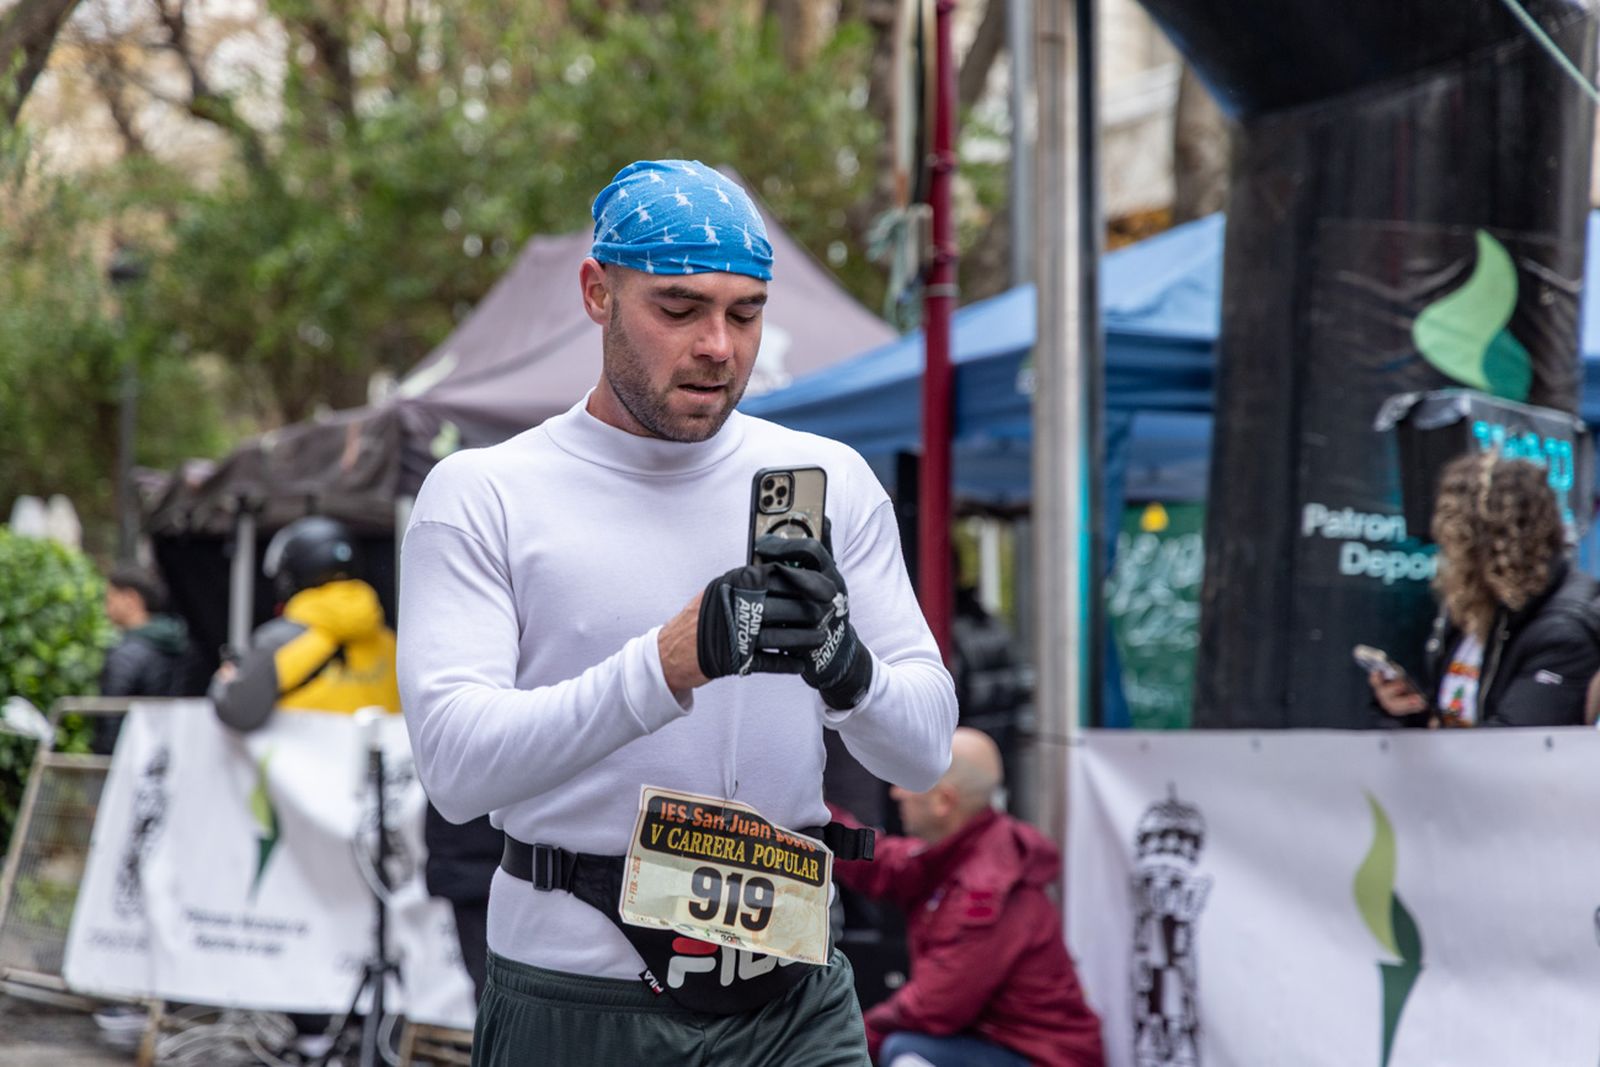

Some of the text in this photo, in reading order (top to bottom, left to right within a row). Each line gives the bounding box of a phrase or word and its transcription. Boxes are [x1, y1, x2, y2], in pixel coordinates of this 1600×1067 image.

[1302, 502, 1408, 542] Patron
[1339, 541, 1438, 585] Depor
[749, 602, 764, 635] SAN
[660, 801, 687, 823] IES
[691, 808, 726, 831] San
[729, 814, 771, 840] Juan
[650, 823, 820, 881] V CARRERA POPULAR
[688, 866, 775, 932] 919
[643, 969, 665, 995] FILA
